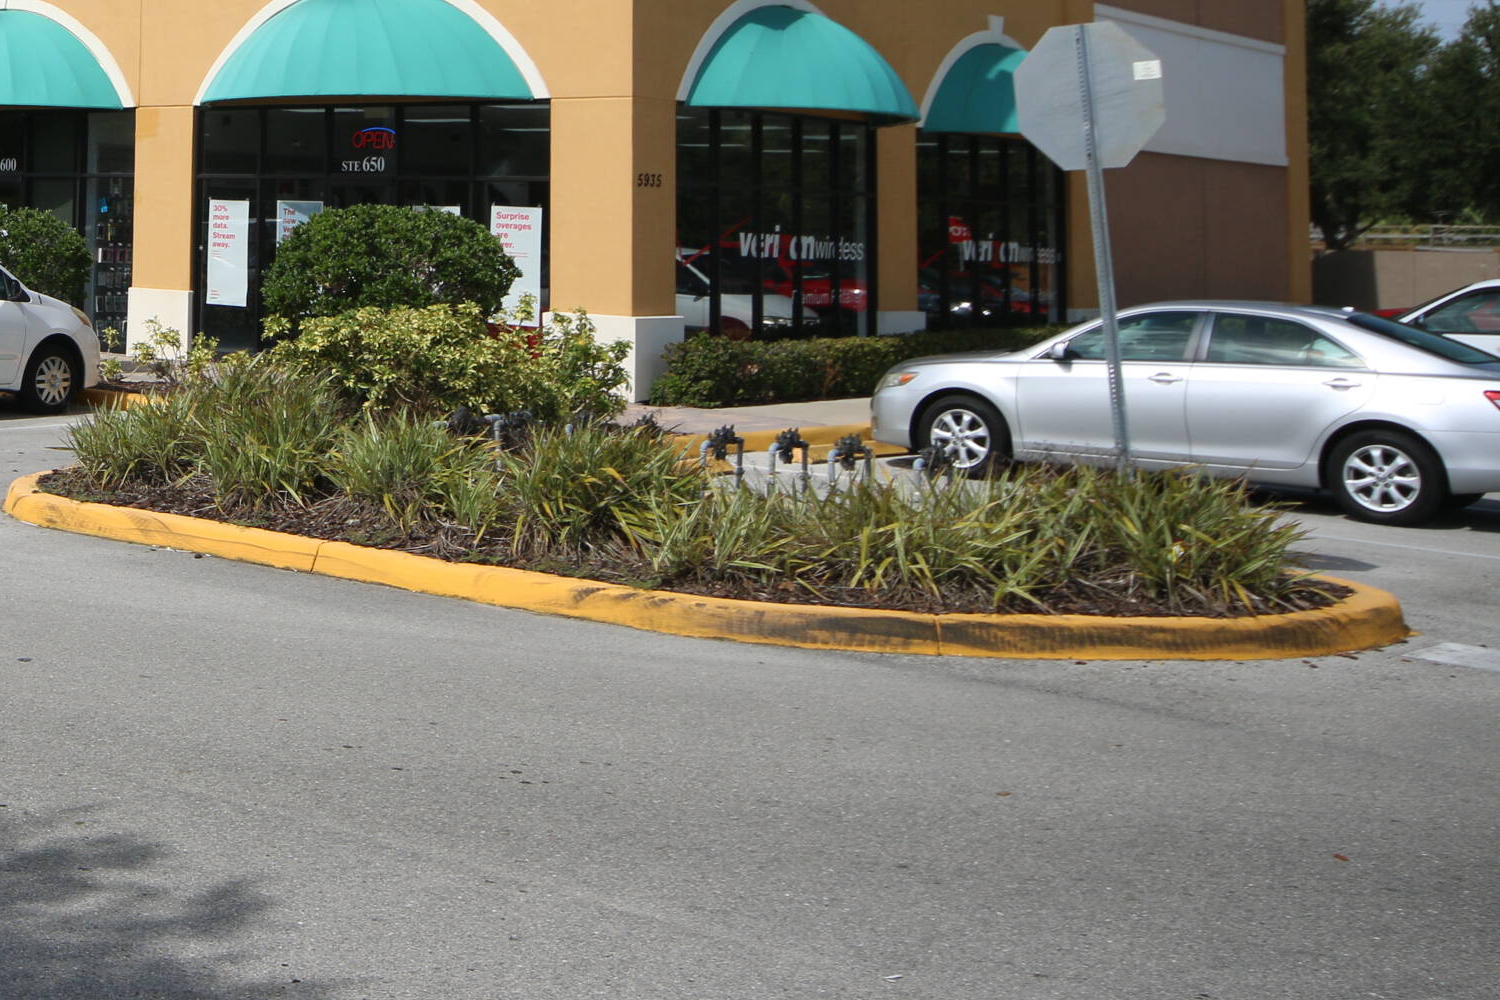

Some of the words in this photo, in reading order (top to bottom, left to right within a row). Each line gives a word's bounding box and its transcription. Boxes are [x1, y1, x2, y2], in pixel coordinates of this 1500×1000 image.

[352, 131, 396, 149] OPEN
[0, 158, 17, 172] 600
[341, 160, 360, 172] STE
[362, 156, 385, 172] 650
[637, 173, 662, 188] 5935
[496, 211, 530, 221] Surprise
[496, 222, 532, 231] overages
